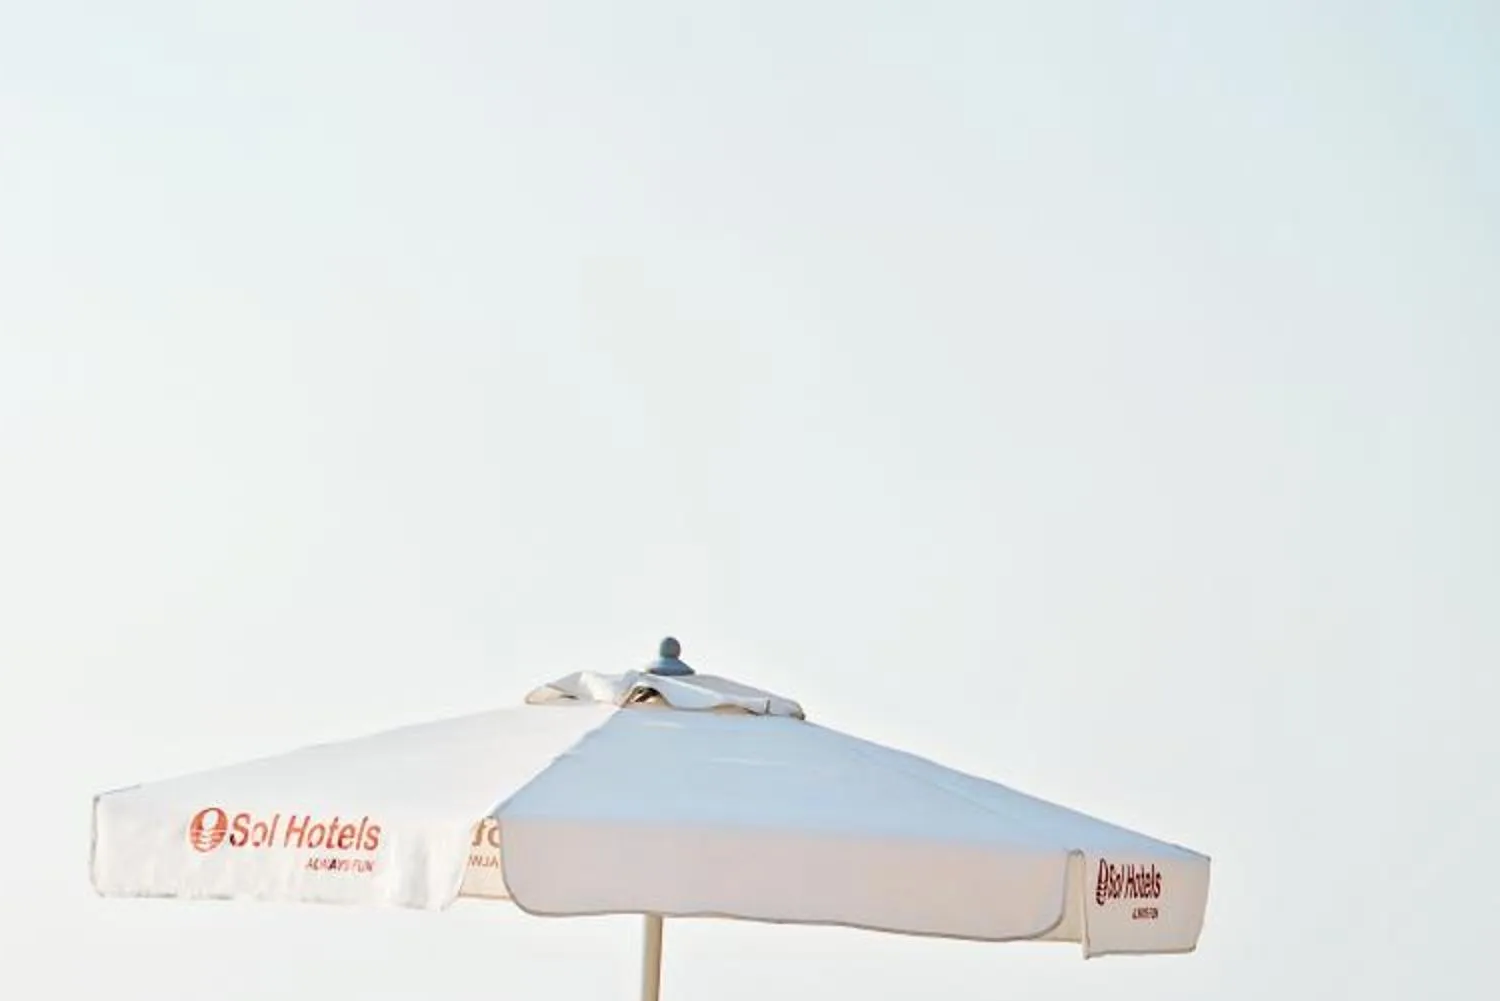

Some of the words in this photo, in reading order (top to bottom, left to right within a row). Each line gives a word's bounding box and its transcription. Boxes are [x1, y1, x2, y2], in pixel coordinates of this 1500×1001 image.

[229, 813, 280, 848] Sol
[284, 815, 382, 851] Hotels
[1124, 863, 1162, 899] Hotels
